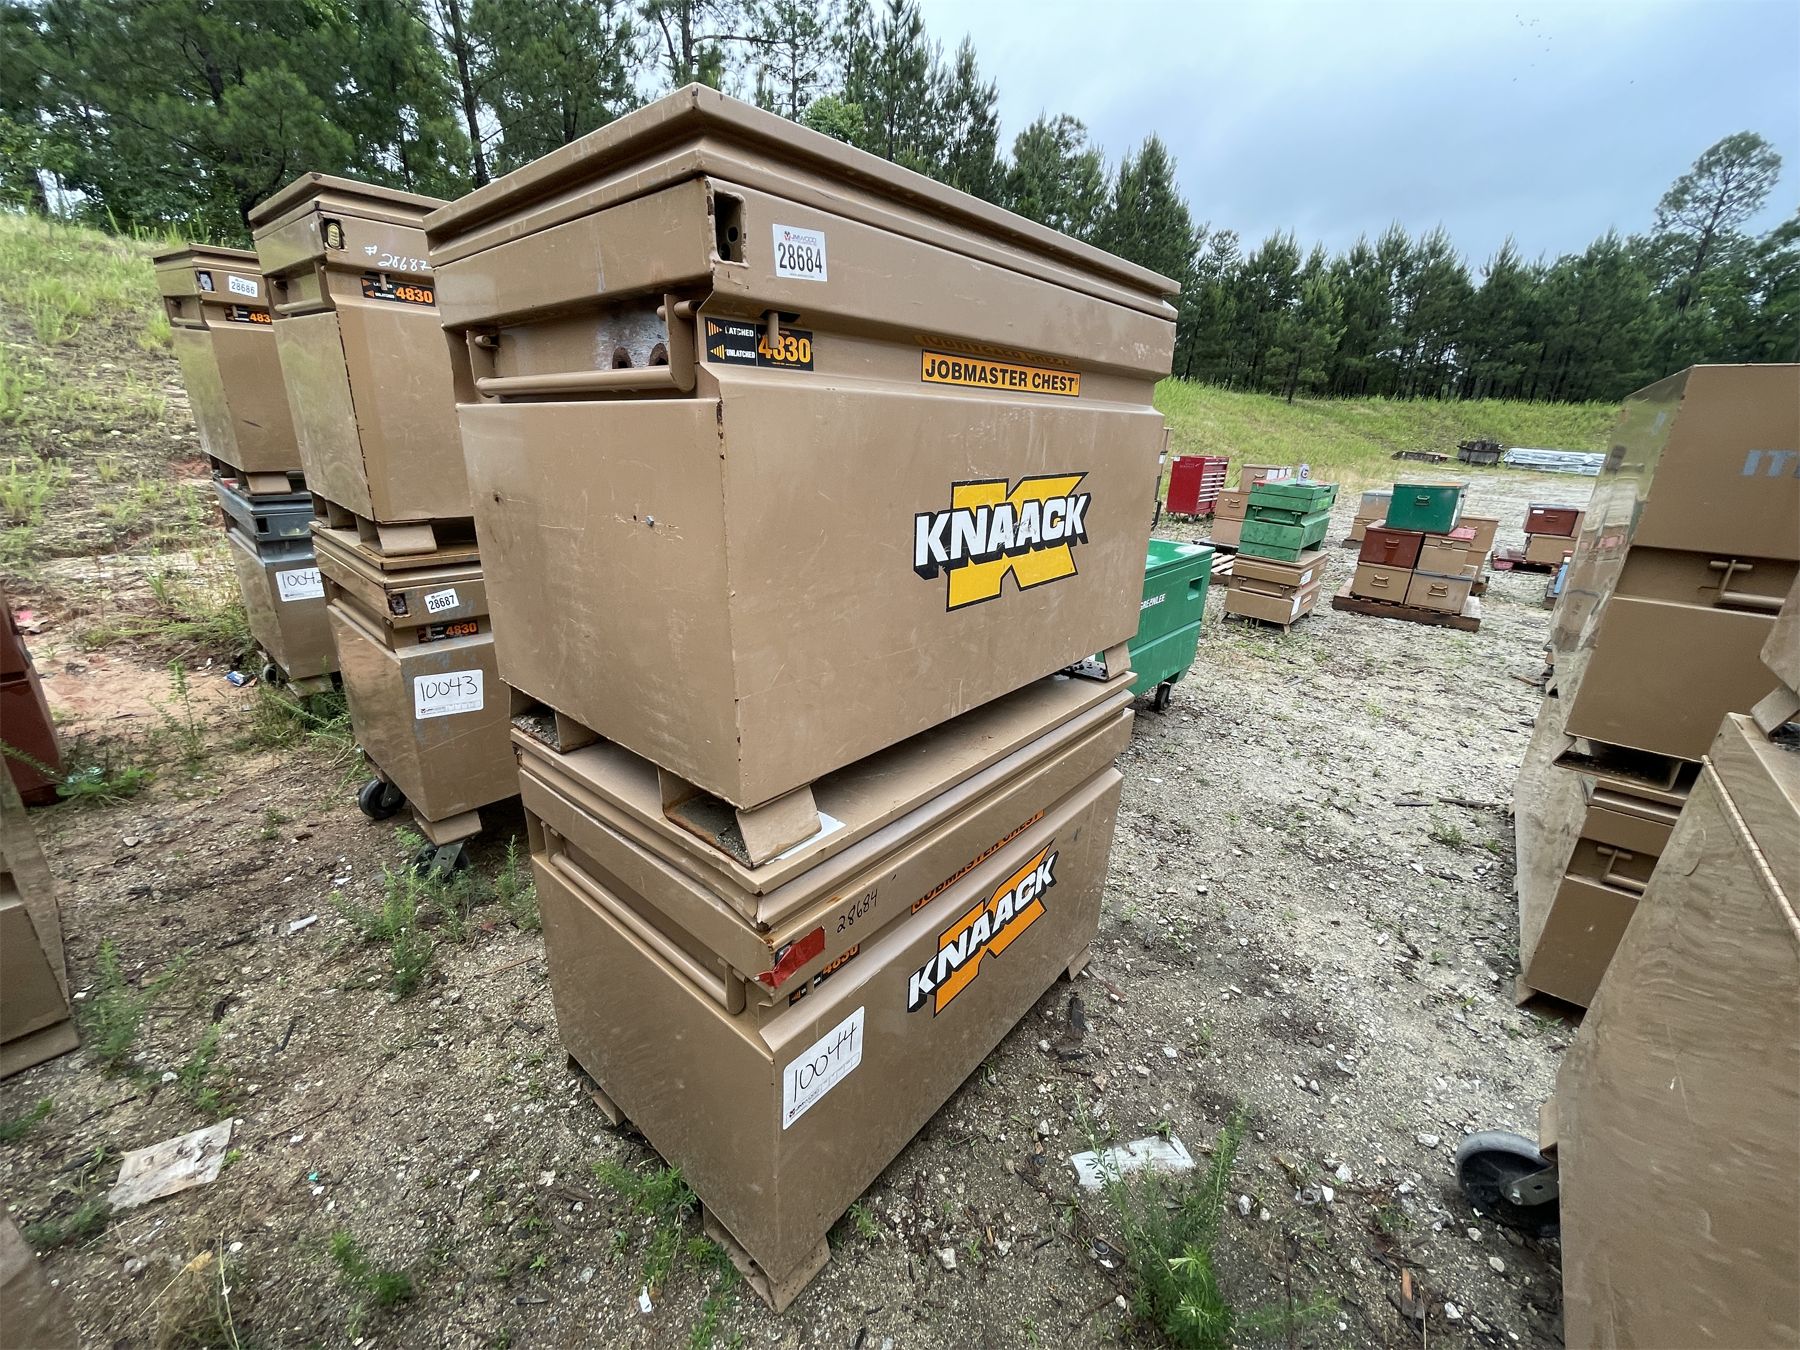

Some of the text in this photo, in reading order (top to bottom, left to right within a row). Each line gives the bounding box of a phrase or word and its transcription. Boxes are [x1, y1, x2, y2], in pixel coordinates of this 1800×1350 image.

[777, 242, 823, 274] 28684
[231, 281, 256, 295] 28686
[395, 286, 434, 304] 4830
[249, 312, 273, 323] 483
[758, 333, 811, 364] 4830
[925, 359, 1075, 392] JOBMASTER CHEST
[914, 492, 1091, 580] KNAACK
[428, 594, 456, 611] 28687
[446, 622, 477, 636] 4830
[420, 675, 478, 702] 10043
[836, 888, 878, 933] 28684
[907, 850, 1060, 1013] KNAACK
[793, 1021, 858, 1103] 10044
